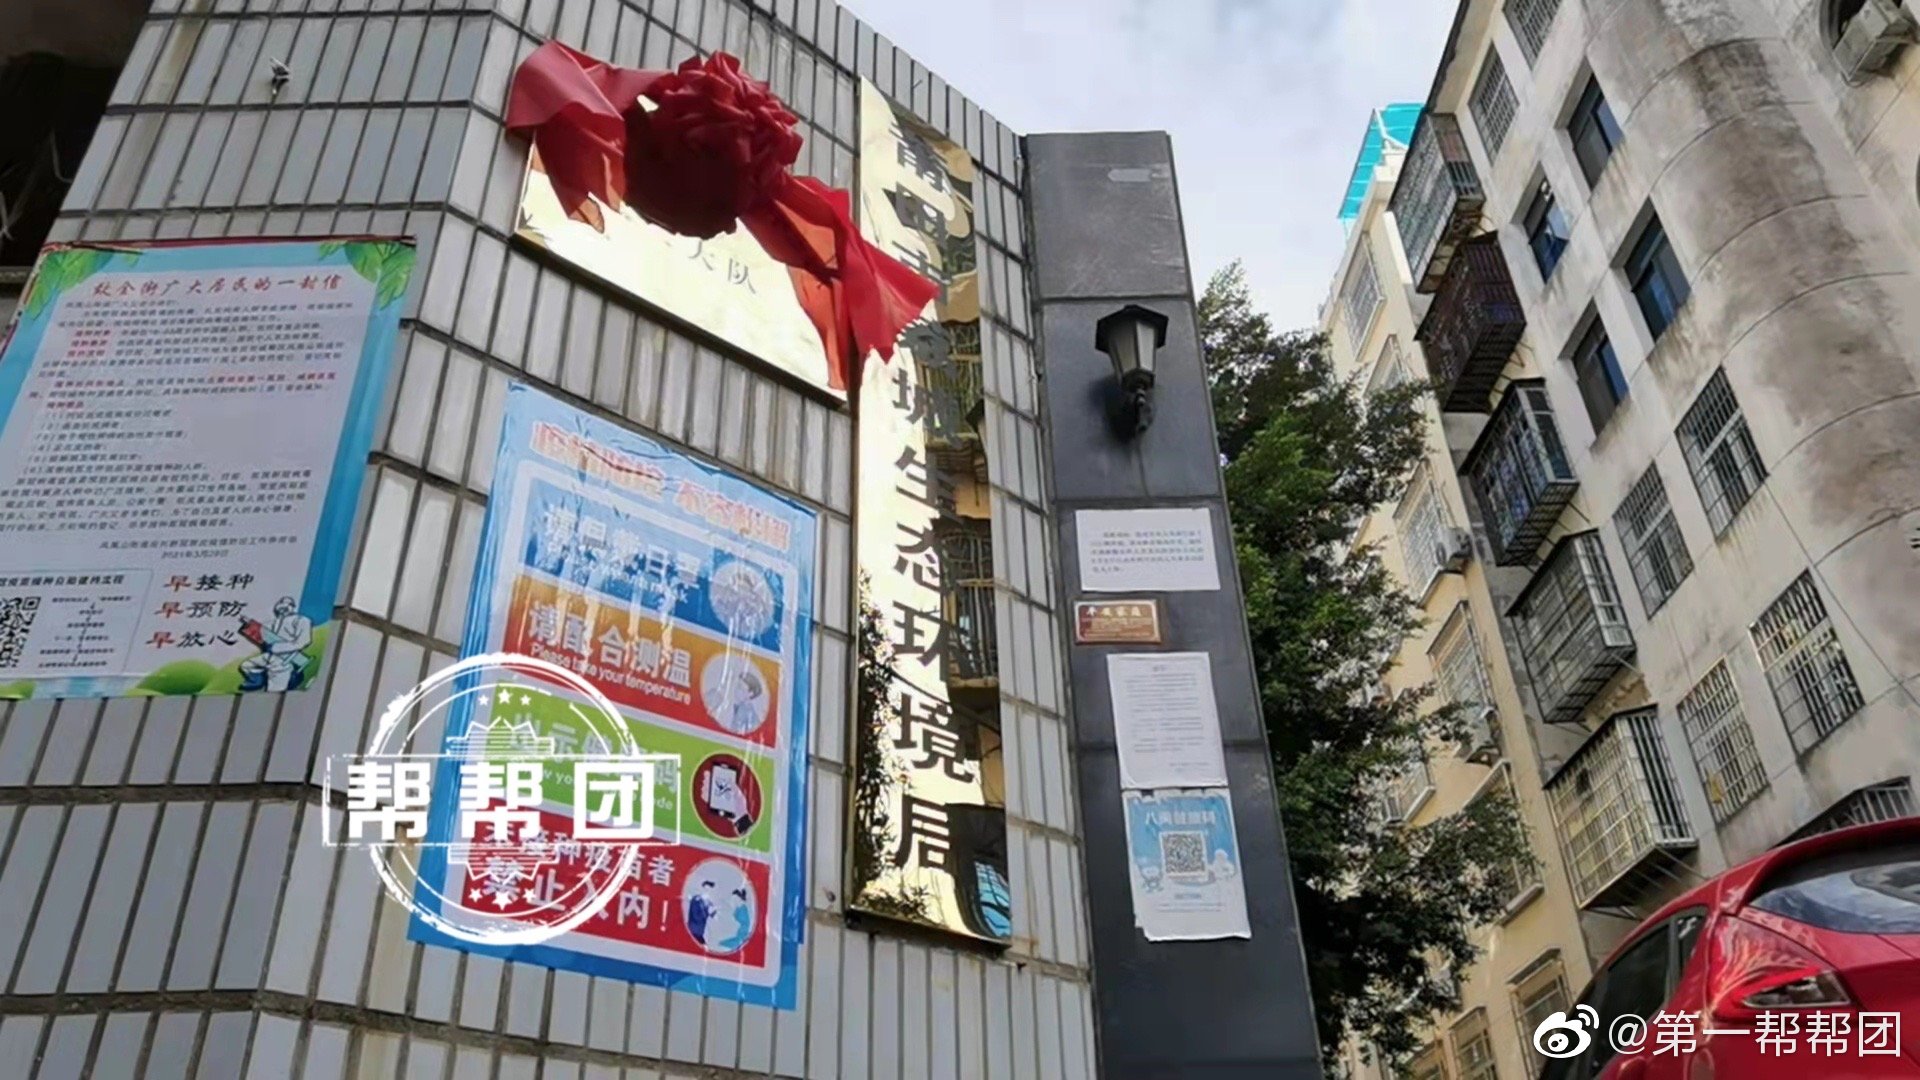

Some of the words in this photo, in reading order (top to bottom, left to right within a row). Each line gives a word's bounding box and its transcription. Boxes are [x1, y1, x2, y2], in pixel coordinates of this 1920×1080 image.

[889, 119, 975, 873] 莆田市城生态环境局
[163, 573, 255, 592] 早接种
[154, 600, 248, 619] 早预防
[145, 630, 240, 650] 早放心
[528, 601, 692, 688] 请配合测温
[598, 667, 625, 682] your
[625, 671, 692, 706] temperature
